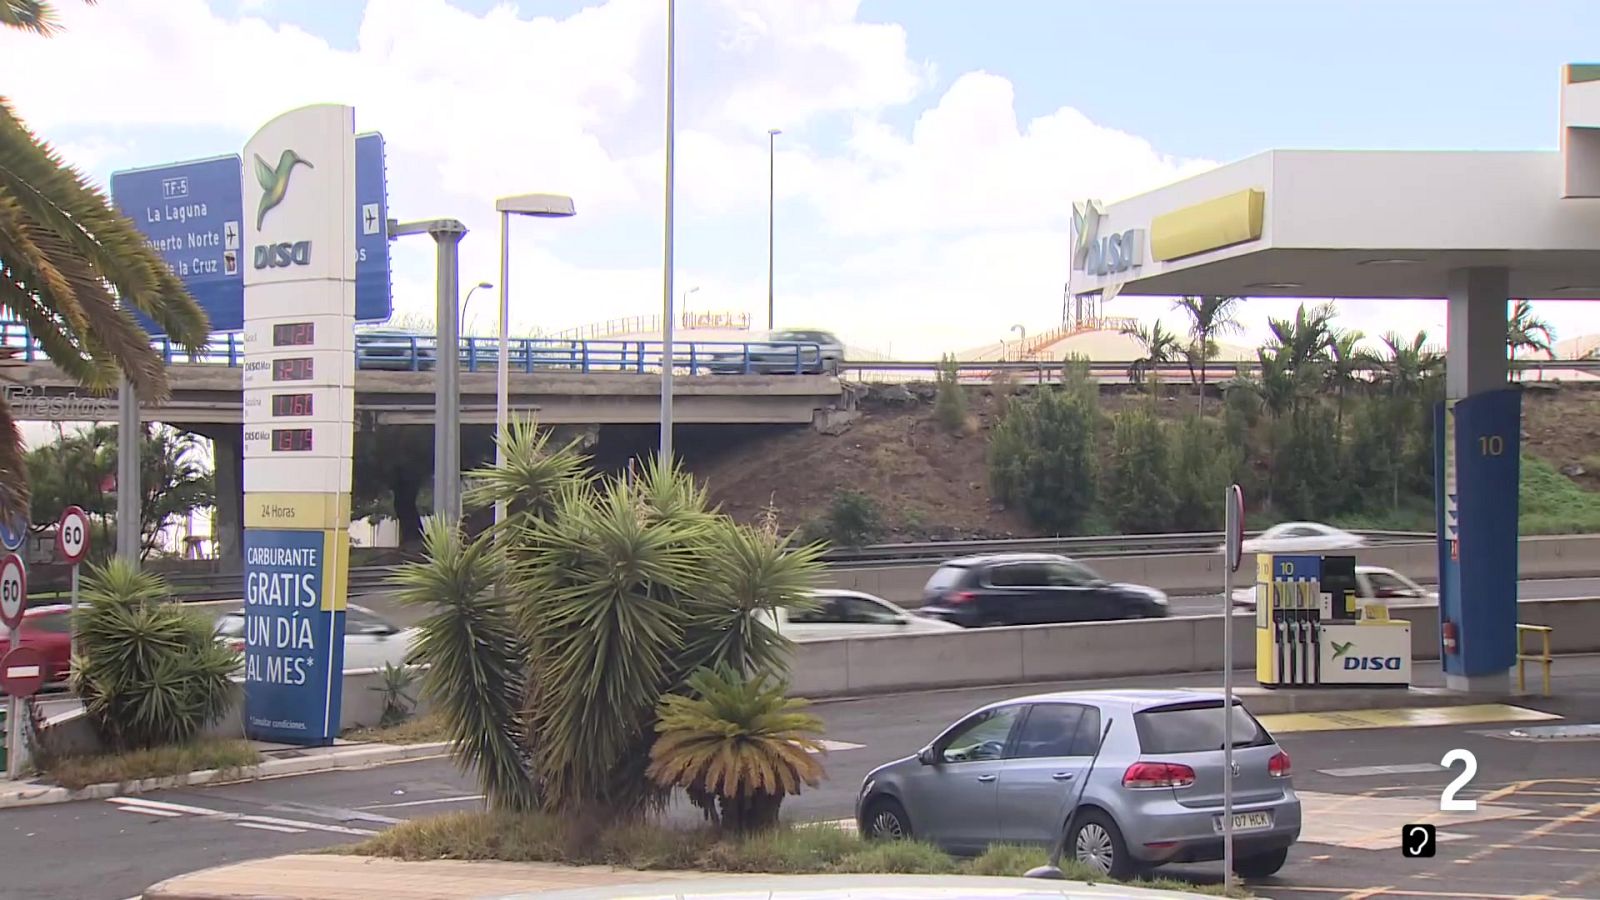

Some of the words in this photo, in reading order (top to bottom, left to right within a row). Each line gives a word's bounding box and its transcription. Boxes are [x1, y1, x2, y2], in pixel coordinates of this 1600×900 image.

[164, 181, 187, 196] TF-5
[146, 207, 161, 223] La
[165, 203, 208, 224] Laguna
[187, 231, 219, 249] Norte
[178, 260, 188, 276] la
[192, 257, 218, 274] Cruz
[1479, 435, 1504, 456] 10
[261, 504, 270, 518] 24
[271, 505, 296, 518] Horas
[64, 526, 81, 545] 60
[247, 547, 317, 567] CARBURANTE
[1280, 562, 1295, 576] 10
[3, 579, 19, 602] 60
[247, 572, 317, 608] GRATIS
[247, 615, 270, 647] UN
[276, 610, 314, 650] DÍA
[247, 654, 263, 682] AL
[1249, 813, 1267, 828] HCK
